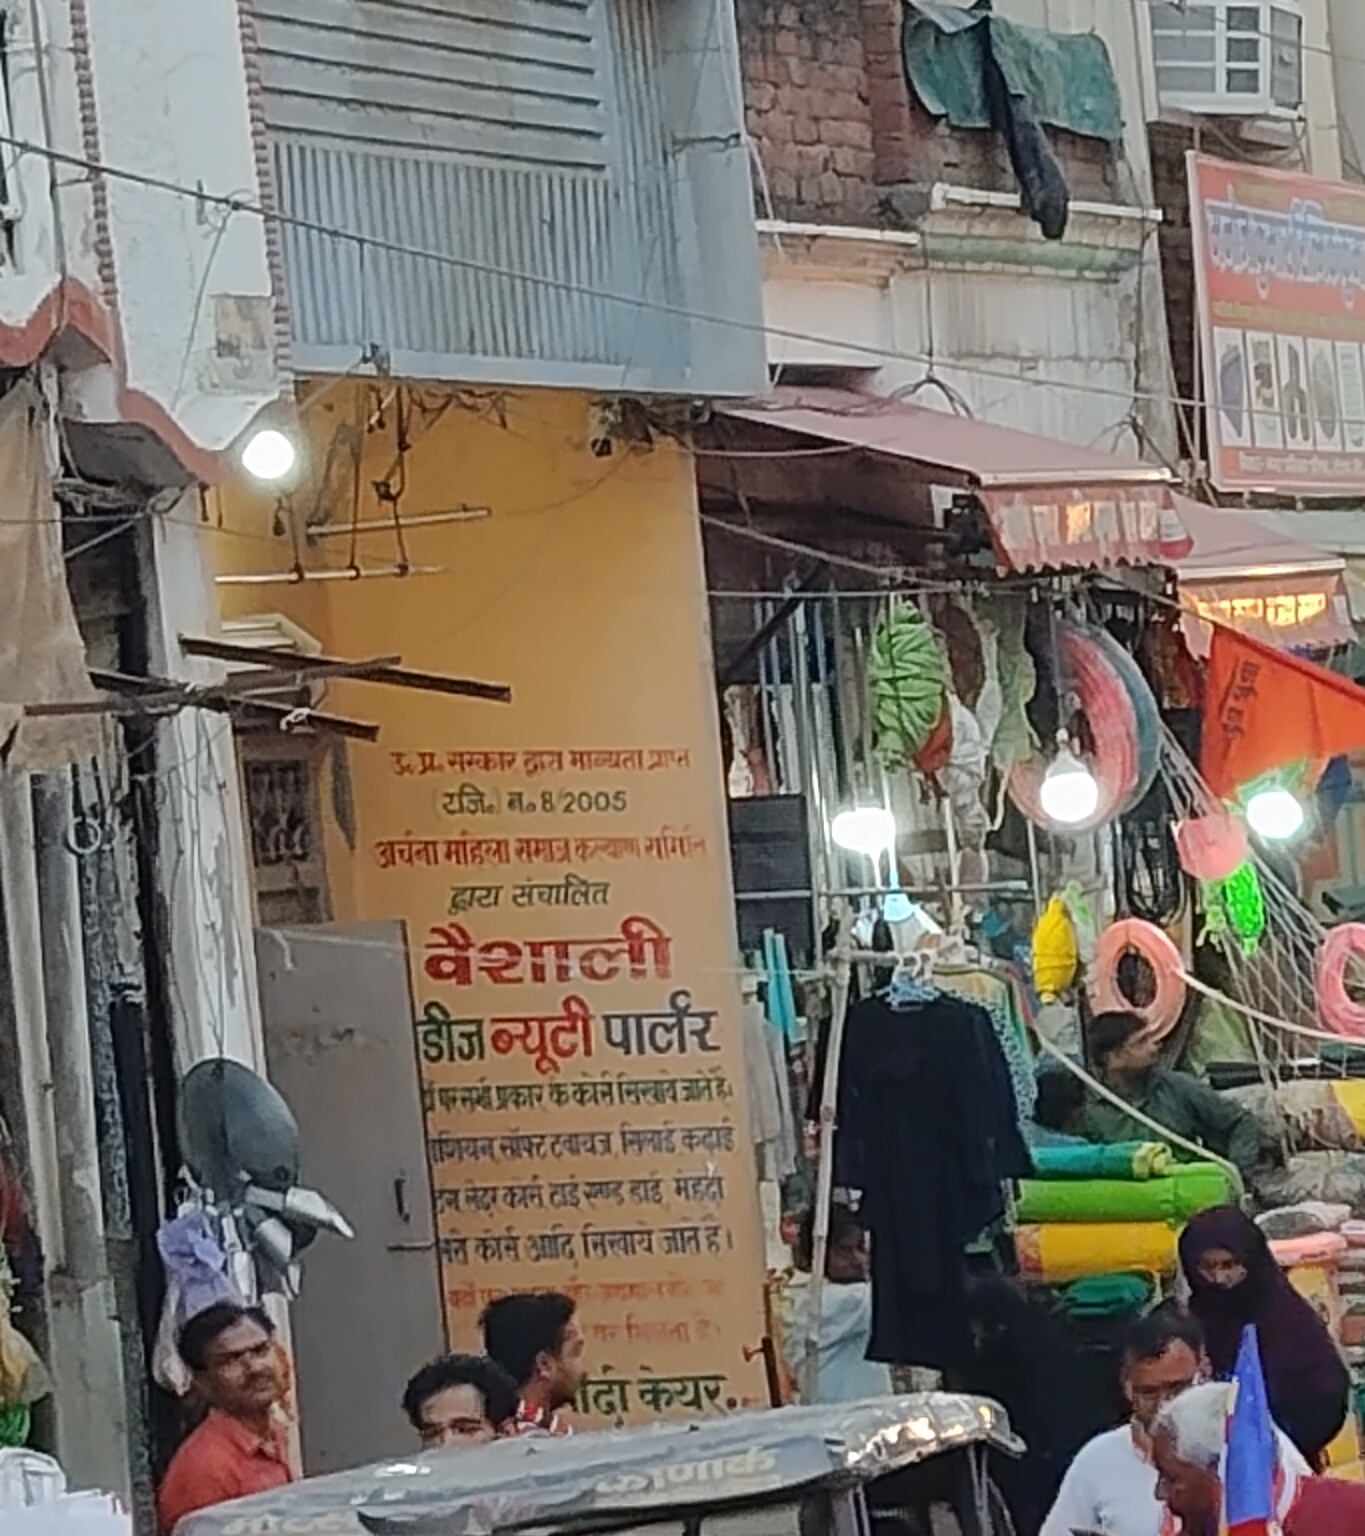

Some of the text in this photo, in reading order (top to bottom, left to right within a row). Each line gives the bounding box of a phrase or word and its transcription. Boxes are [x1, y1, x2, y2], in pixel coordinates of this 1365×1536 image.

[448, 886, 501, 914] द्वारा
[424, 916, 672, 985] वैशाली
[416, 990, 720, 1074] डीज ब्यूटी पार्लर
